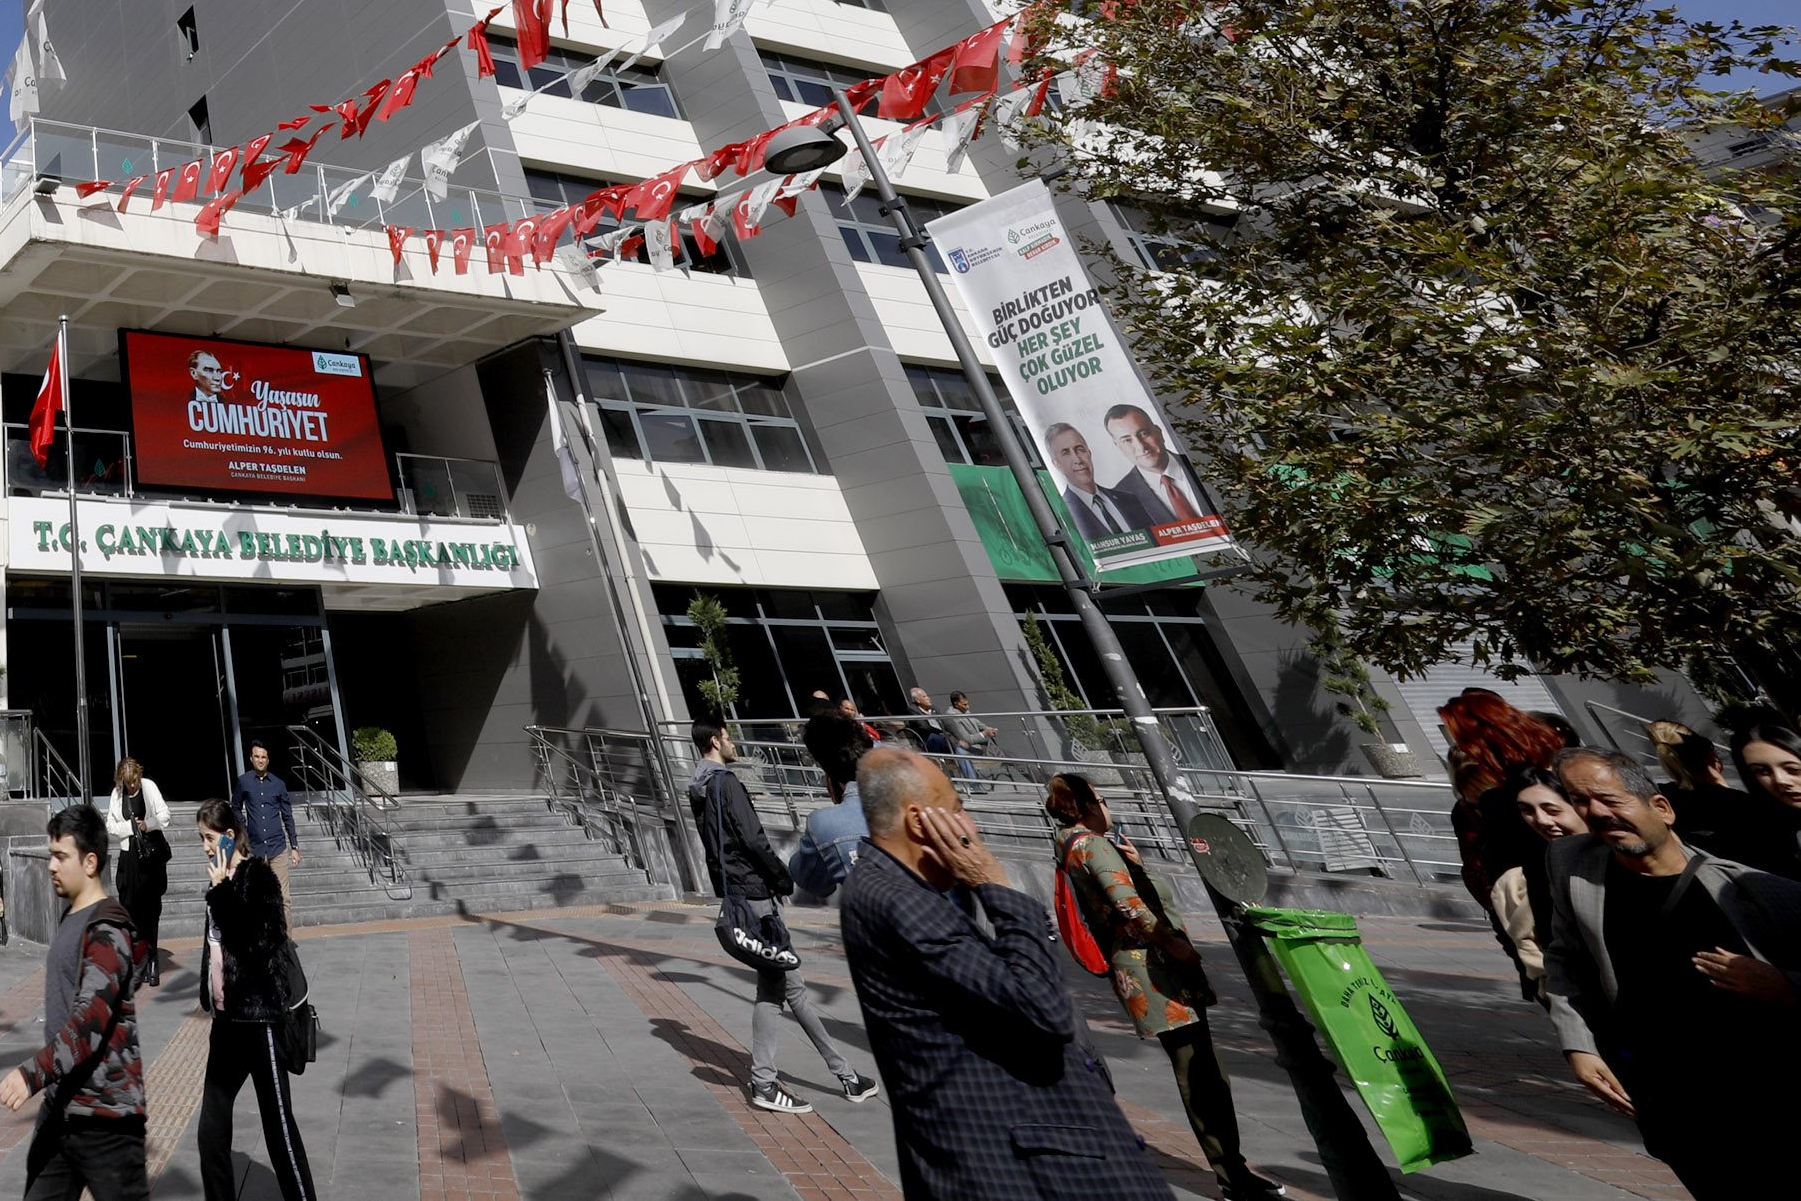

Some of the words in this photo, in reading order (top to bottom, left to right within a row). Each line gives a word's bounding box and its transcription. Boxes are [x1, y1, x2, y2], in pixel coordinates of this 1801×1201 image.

[1019, 219, 1056, 237] Çankaya
[987, 323, 1018, 348] GÜÇ
[1018, 288, 1101, 336] DOĞUYOR
[992, 276, 1073, 325] BİRLİKTEN
[1017, 332, 1049, 358] HER
[1050, 316, 1080, 346] ŞEY
[1019, 353, 1049, 383] ÇOK
[1051, 333, 1104, 365] GÜZEL
[1037, 356, 1103, 395] OLUYOR
[250, 380, 321, 412] Yaşasın
[187, 400, 328, 442] CUMHURİYET
[183, 439, 261, 454] Cumhuriyetimizin
[262, 445, 276, 455] 96.
[278, 447, 291, 457] yılı
[292, 448, 315, 458] kutlu
[317, 450, 343, 459] olsun.
[228, 461, 258, 471] ALPER
[259, 462, 306, 475] TAŞDELEN
[95, 524, 232, 557] ÇANKAYA
[238, 529, 366, 560] BELEDİYE
[370, 538, 519, 569] BAŞKANLIĞI
[1158, 526, 1182, 537] ALPER
[734, 928, 798, 964] adidas
[1341, 987, 1355, 1008] DAHA
